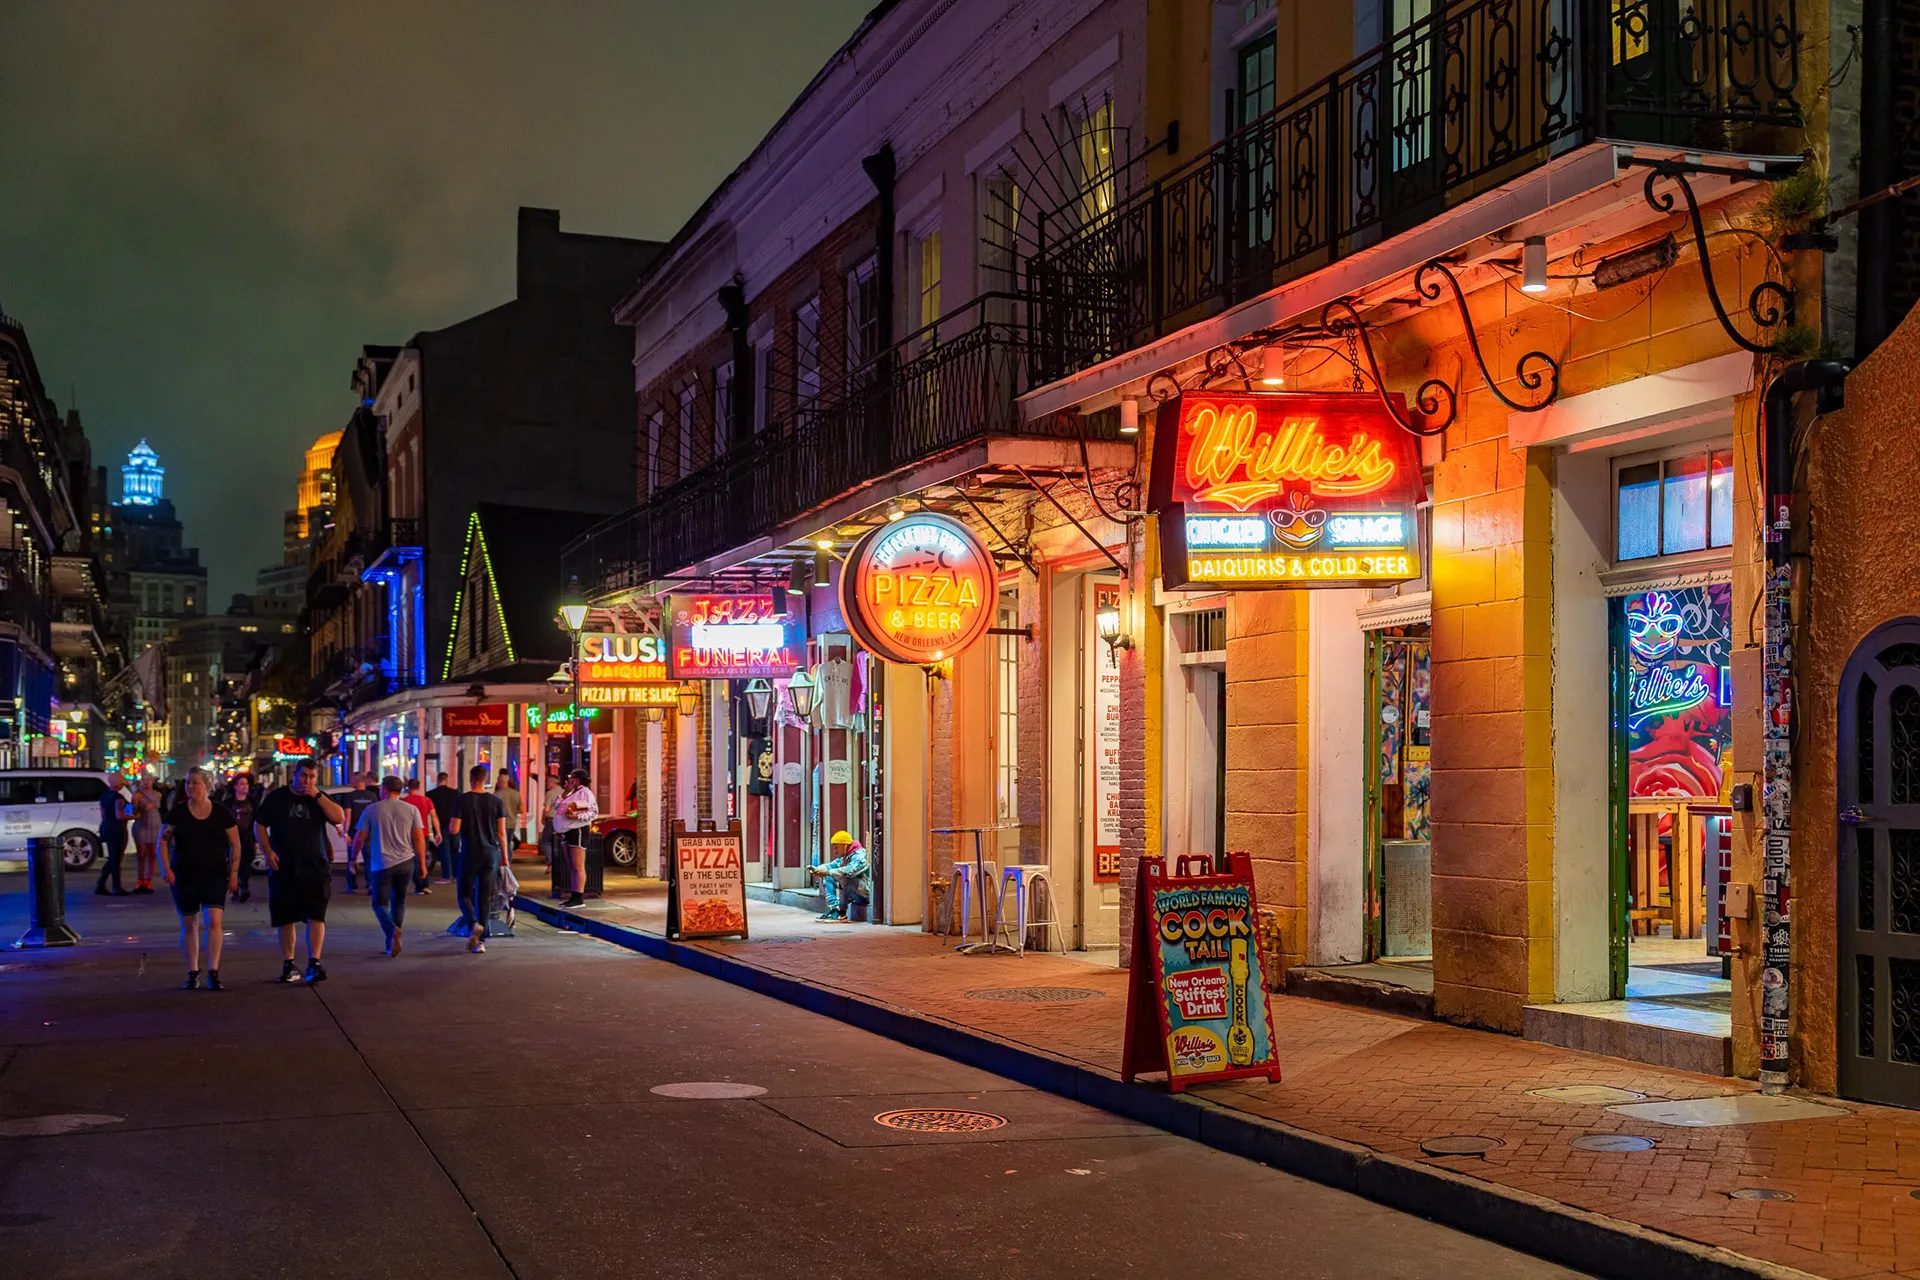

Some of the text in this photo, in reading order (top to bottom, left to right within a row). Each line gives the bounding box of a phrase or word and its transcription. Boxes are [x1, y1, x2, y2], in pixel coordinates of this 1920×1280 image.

[1185, 402, 1394, 490] Willie's
[1191, 556, 1409, 578] DAIQUIRIS & COLD BEER
[872, 574, 979, 609] PIZZA
[691, 600, 780, 625] JAZZ
[891, 610, 961, 631] & BEER
[894, 631, 911, 644] NEW
[948, 632, 958, 643] LA
[677, 647, 798, 668] FUNERAL
[582, 687, 677, 703] PIZZA BY THE SLICE
[445, 712, 504, 727] Famous Door
[682, 838, 735, 847] GRAB AND GO
[680, 848, 740, 869] PIZZA
[683, 870, 738, 880] BY THE SLICE
[1157, 892, 1248, 913] WORLD FAMOUS
[1161, 908, 1250, 940] COCK
[1185, 939, 1228, 960] TAIL
[1169, 976, 1226, 989] New Orleans
[1175, 986, 1226, 1002] Stiffest
[1186, 1000, 1222, 1016] Drink
[1236, 988, 1244, 1022] COCK
[1174, 1035, 1216, 1053] Willie's
